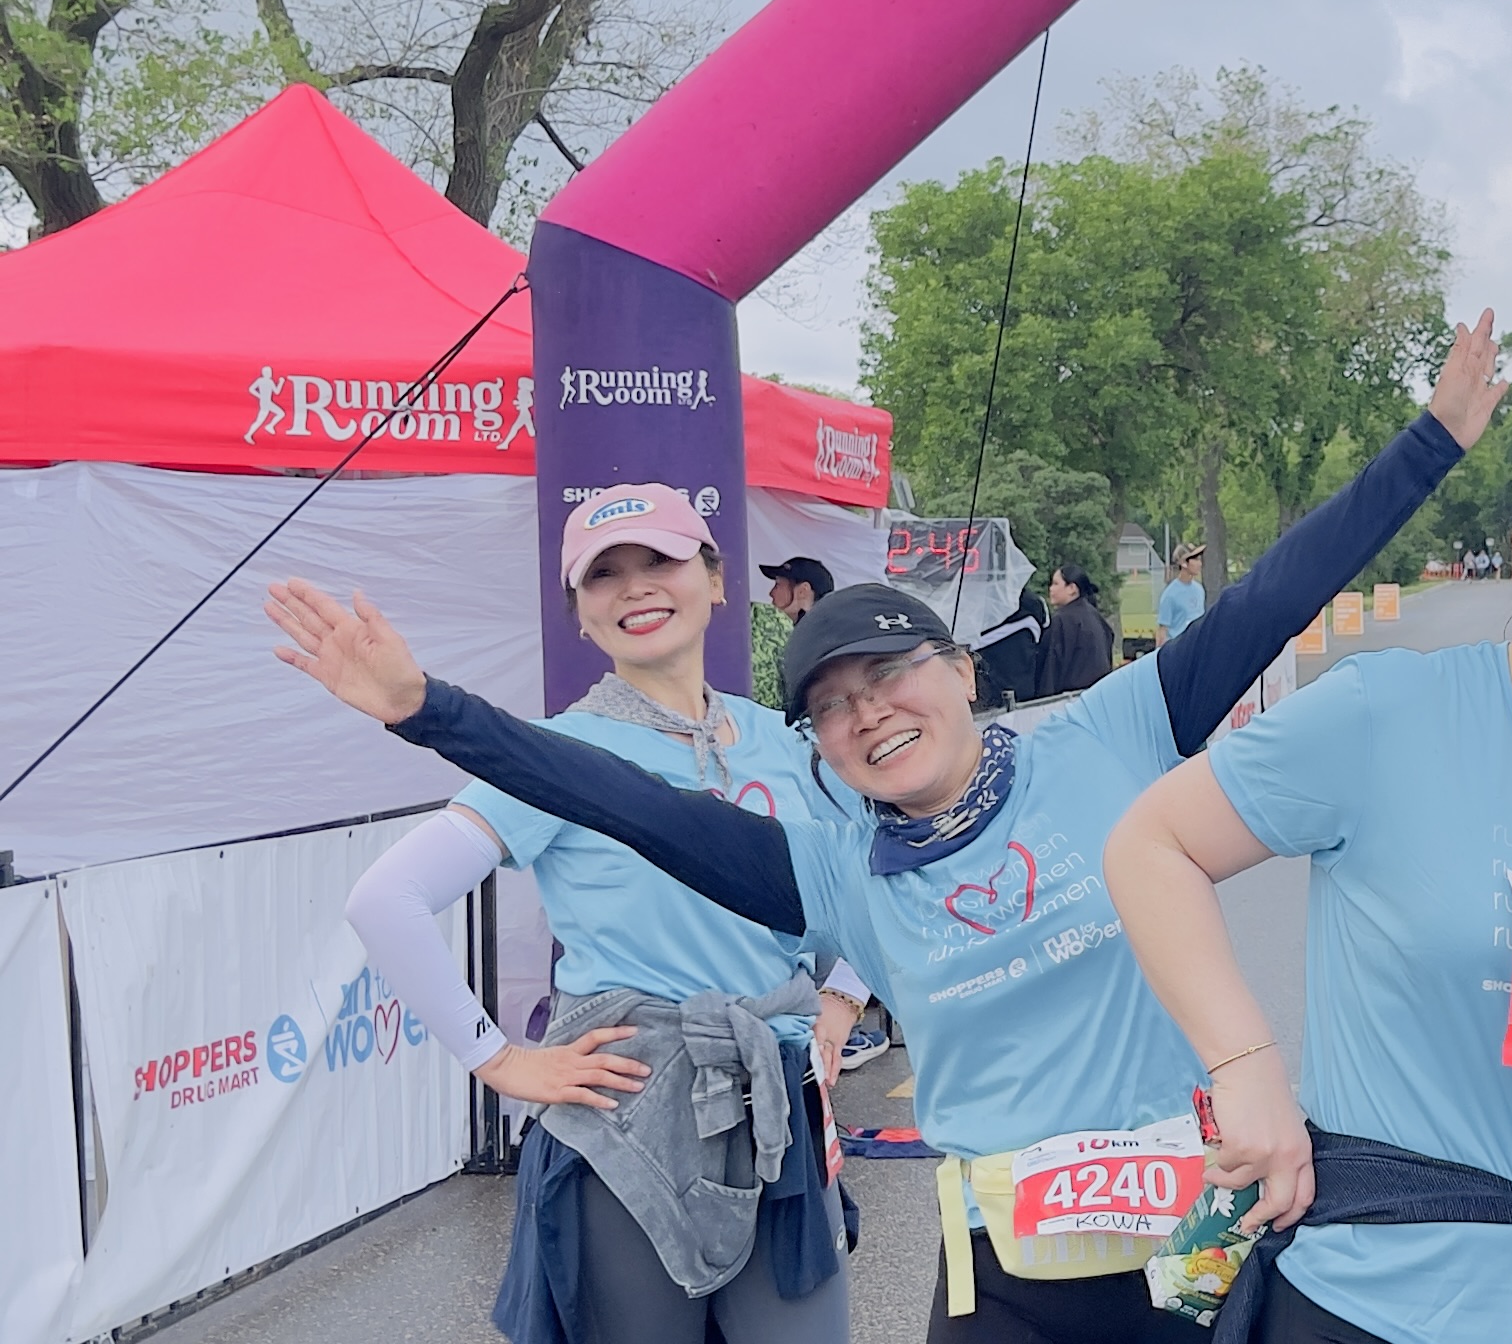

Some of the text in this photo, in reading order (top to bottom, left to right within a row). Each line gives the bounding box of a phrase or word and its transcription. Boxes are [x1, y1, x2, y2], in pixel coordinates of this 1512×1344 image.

[286, 370, 504, 441] Running
[576, 366, 694, 406] Running
[1043, 927, 1080, 953] run
[929, 967, 1005, 1003] SHOPPERS
[171, 1067, 259, 1109] DRUG MART
[1043, 1160, 1178, 1209] 4240
[1076, 1214, 1152, 1232] KOWA
